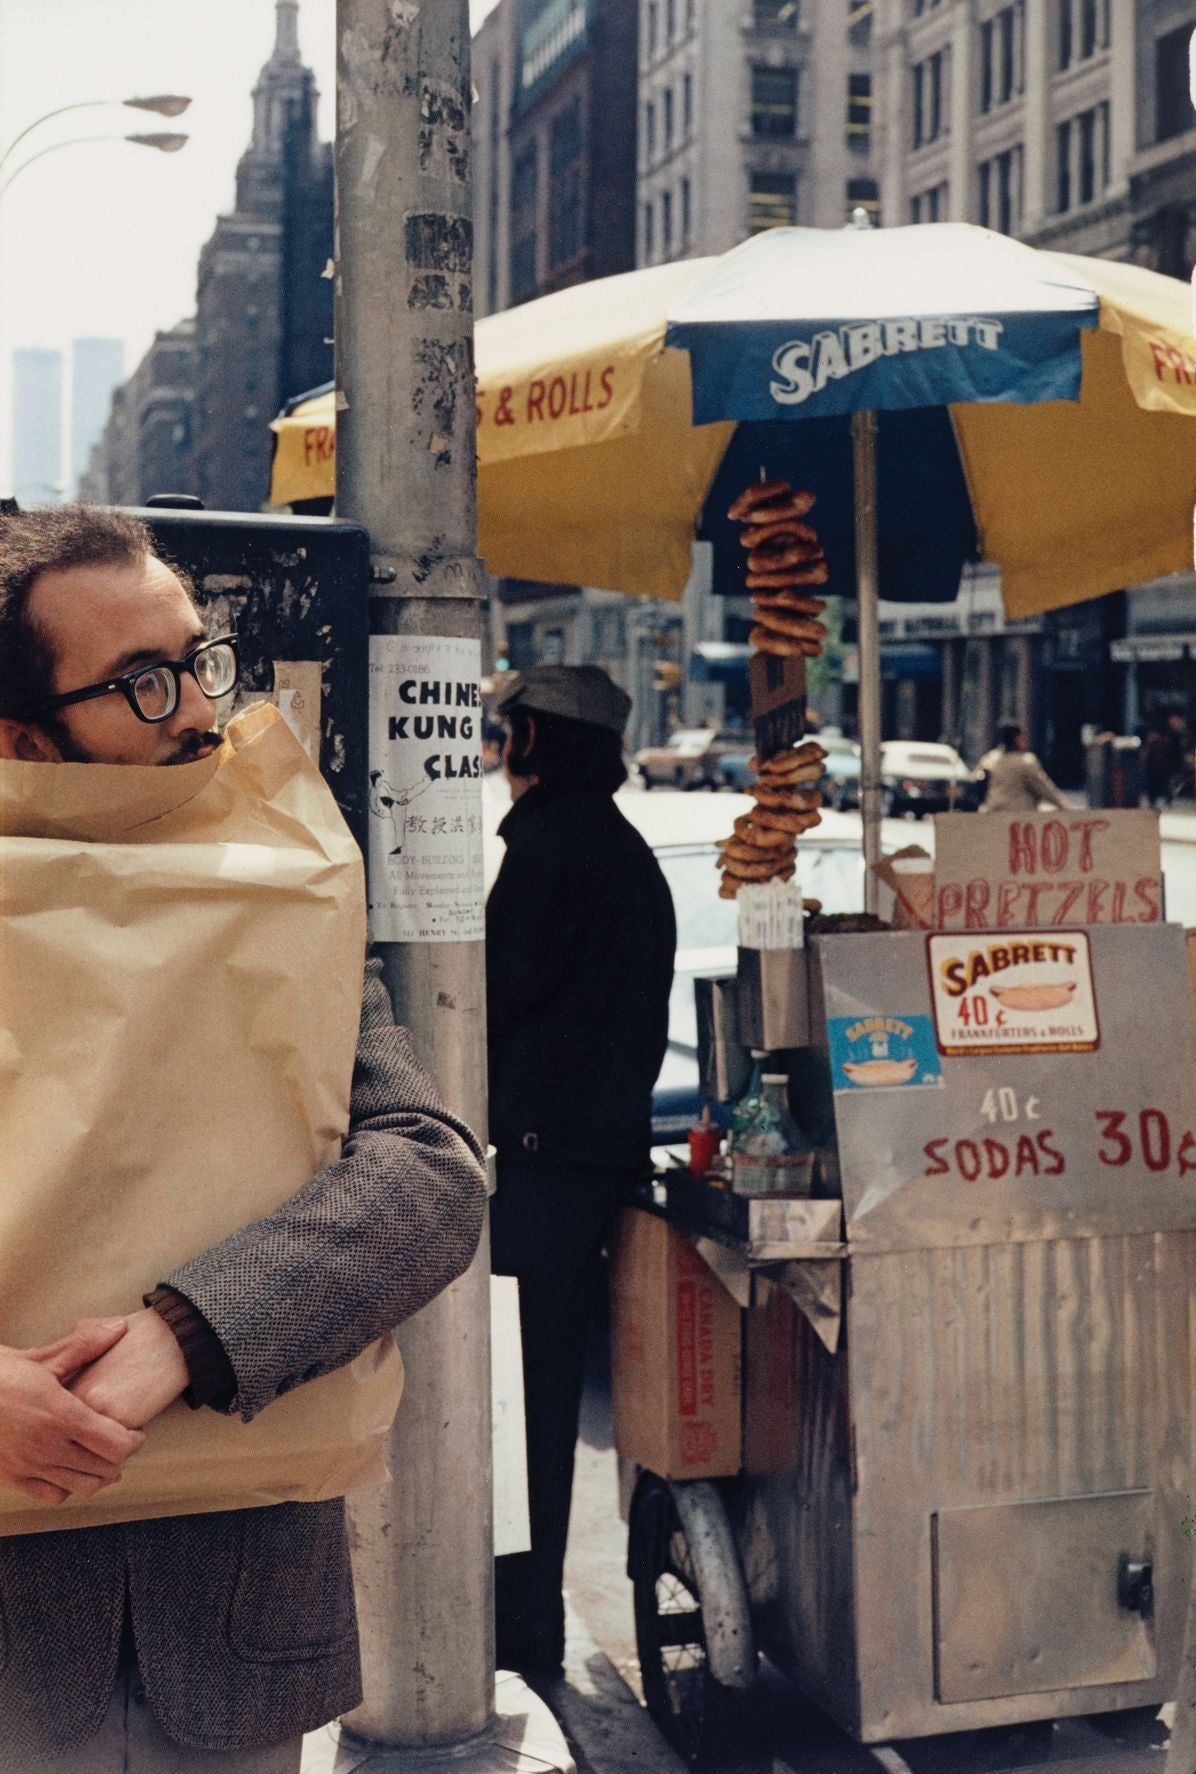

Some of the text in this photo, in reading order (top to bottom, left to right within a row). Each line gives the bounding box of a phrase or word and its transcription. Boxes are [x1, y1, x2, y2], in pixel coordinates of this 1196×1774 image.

[770, 318, 1003, 404] SABRETT
[1149, 341, 1196, 385] FR
[494, 386, 515, 426] &
[527, 365, 615, 422] ROLLS
[399, 680, 481, 707] CHINE
[389, 715, 473, 740] KUNG
[424, 754, 482, 781] CLAS
[1008, 820, 1110, 875] HOT
[936, 877, 1160, 930] PRETZELS
[940, 940, 1077, 998] SABRETT
[923, 1129, 1065, 1181] SODAS
